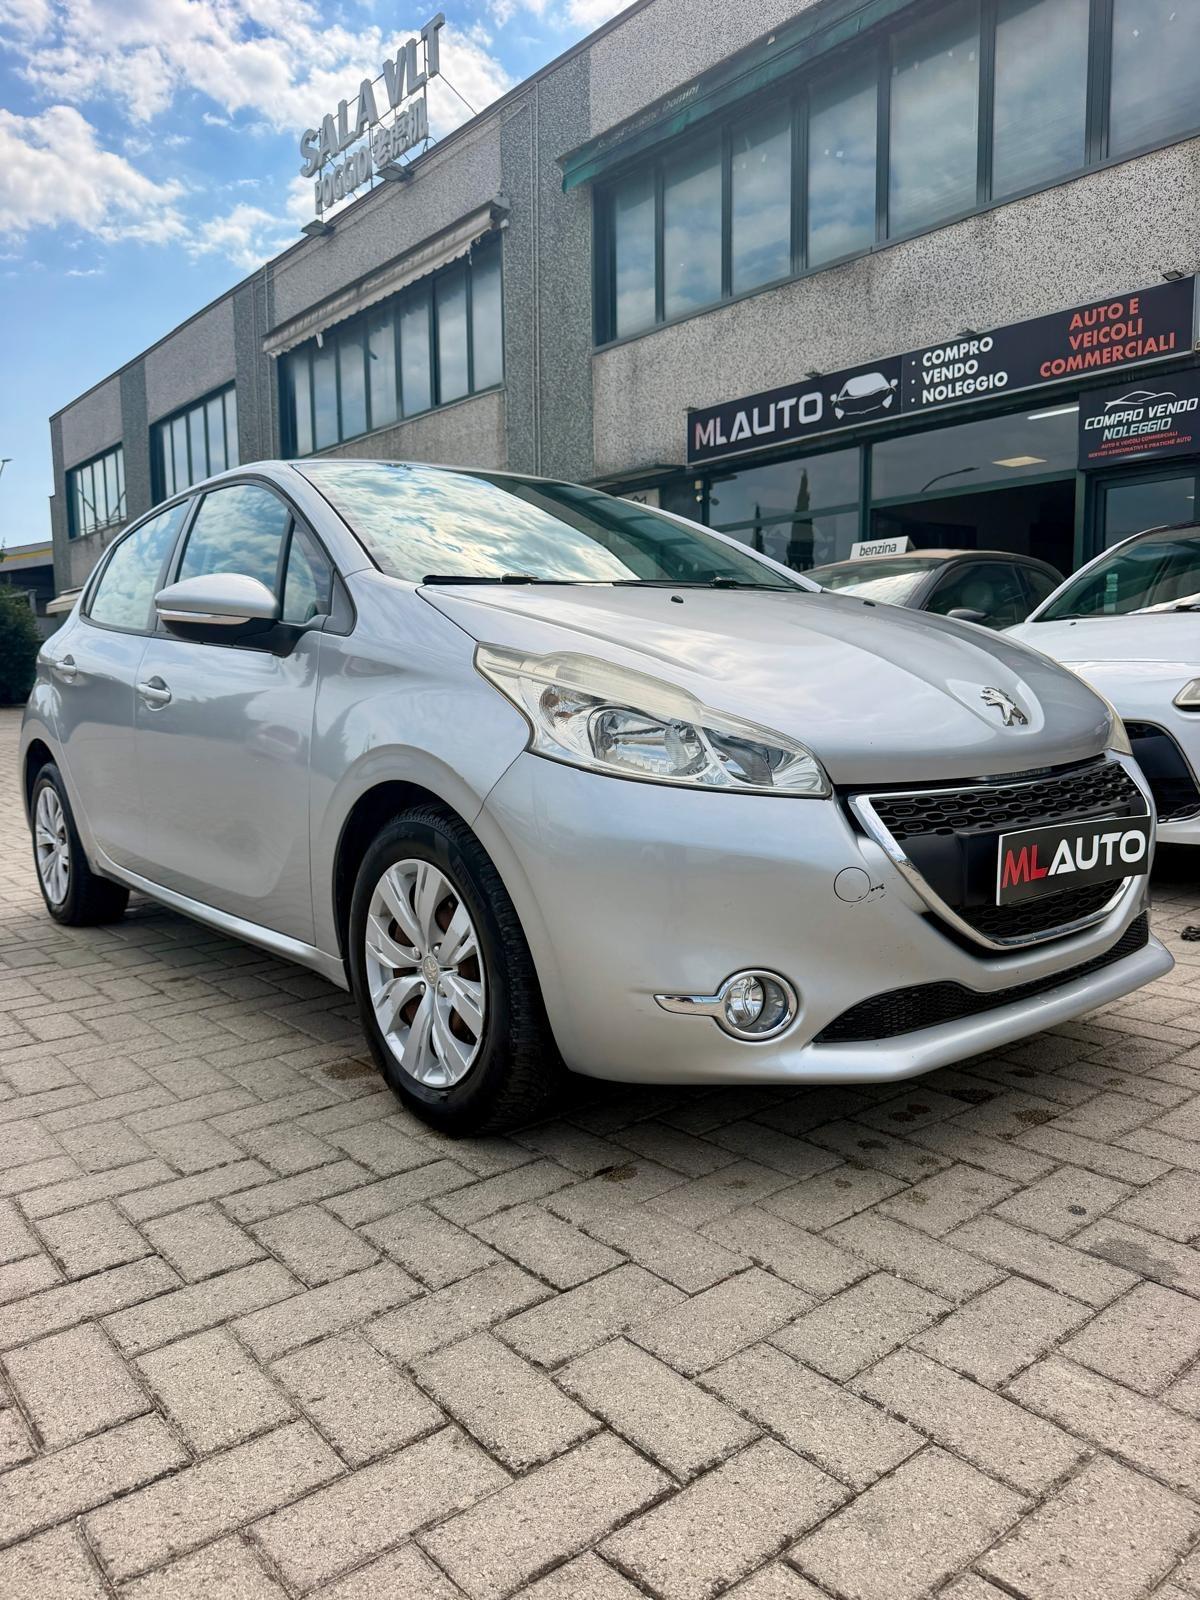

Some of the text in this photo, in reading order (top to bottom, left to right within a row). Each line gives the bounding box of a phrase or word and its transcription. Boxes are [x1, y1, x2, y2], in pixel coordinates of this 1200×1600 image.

[300, 12, 446, 178] SALA VLT
[314, 145, 373, 215] POGGIO
[1069, 298, 1139, 331] AUTO E
[1069, 318, 1143, 351] VEICOLI
[922, 336, 994, 367] COMPRO
[1039, 332, 1175, 378] COMMERCIALI
[922, 359, 979, 385] VENDO
[922, 371, 1009, 404] NOLEGGIO
[1084, 398, 1199, 430] COMPRO VENDO
[1102, 417, 1172, 442] NOLEGGIO
[1101, 441, 1115, 449] AUTO
[1120, 437, 1140, 446] VEICOLI
[1141, 431, 1178, 442] COMMERCIALI
[1149, 439, 1175, 448] PRATICHE
[1176, 435, 1192, 444] AUTO
[859, 542, 897, 557] benzina
